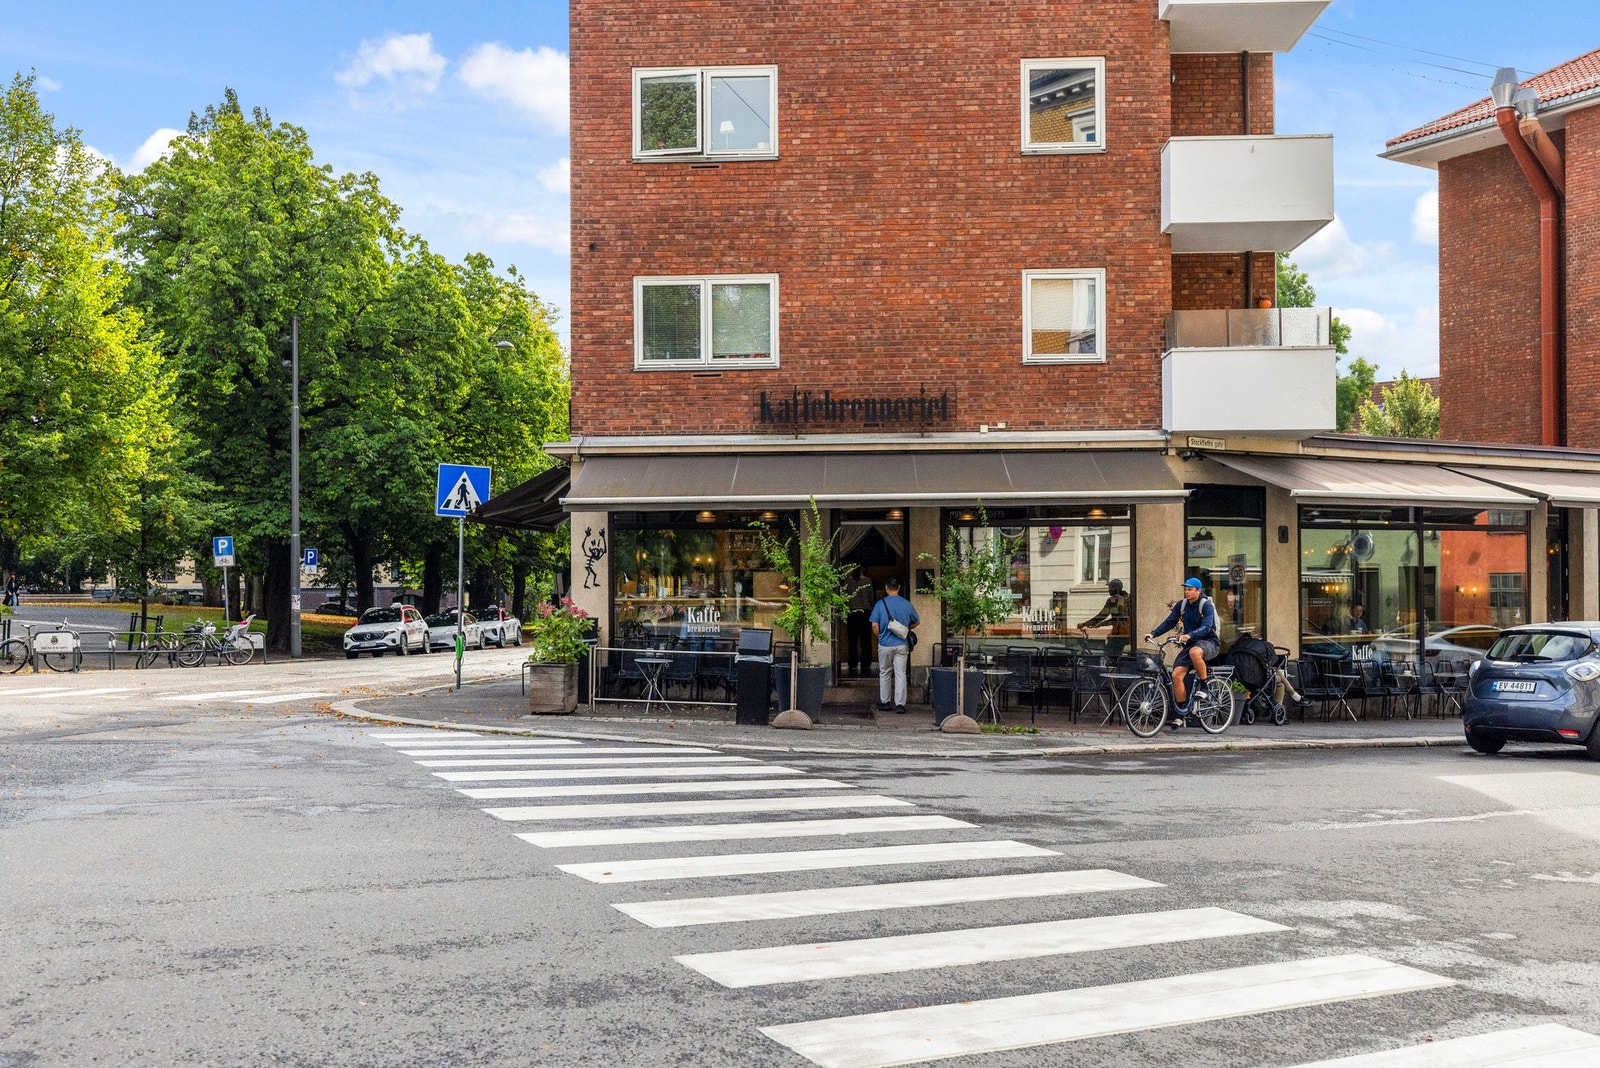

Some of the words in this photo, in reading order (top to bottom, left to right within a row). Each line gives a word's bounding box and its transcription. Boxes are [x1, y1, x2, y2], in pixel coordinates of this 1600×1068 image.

[760, 388, 947, 424] Kaffebrenneriet
[218, 540, 228, 554] P
[307, 551, 315, 563] P
[687, 605, 720, 623] Kaffe
[1022, 605, 1056, 622] Kaffe
[1352, 645, 1373, 660] Kaffe
[1510, 682, 1532, 690] 44811
